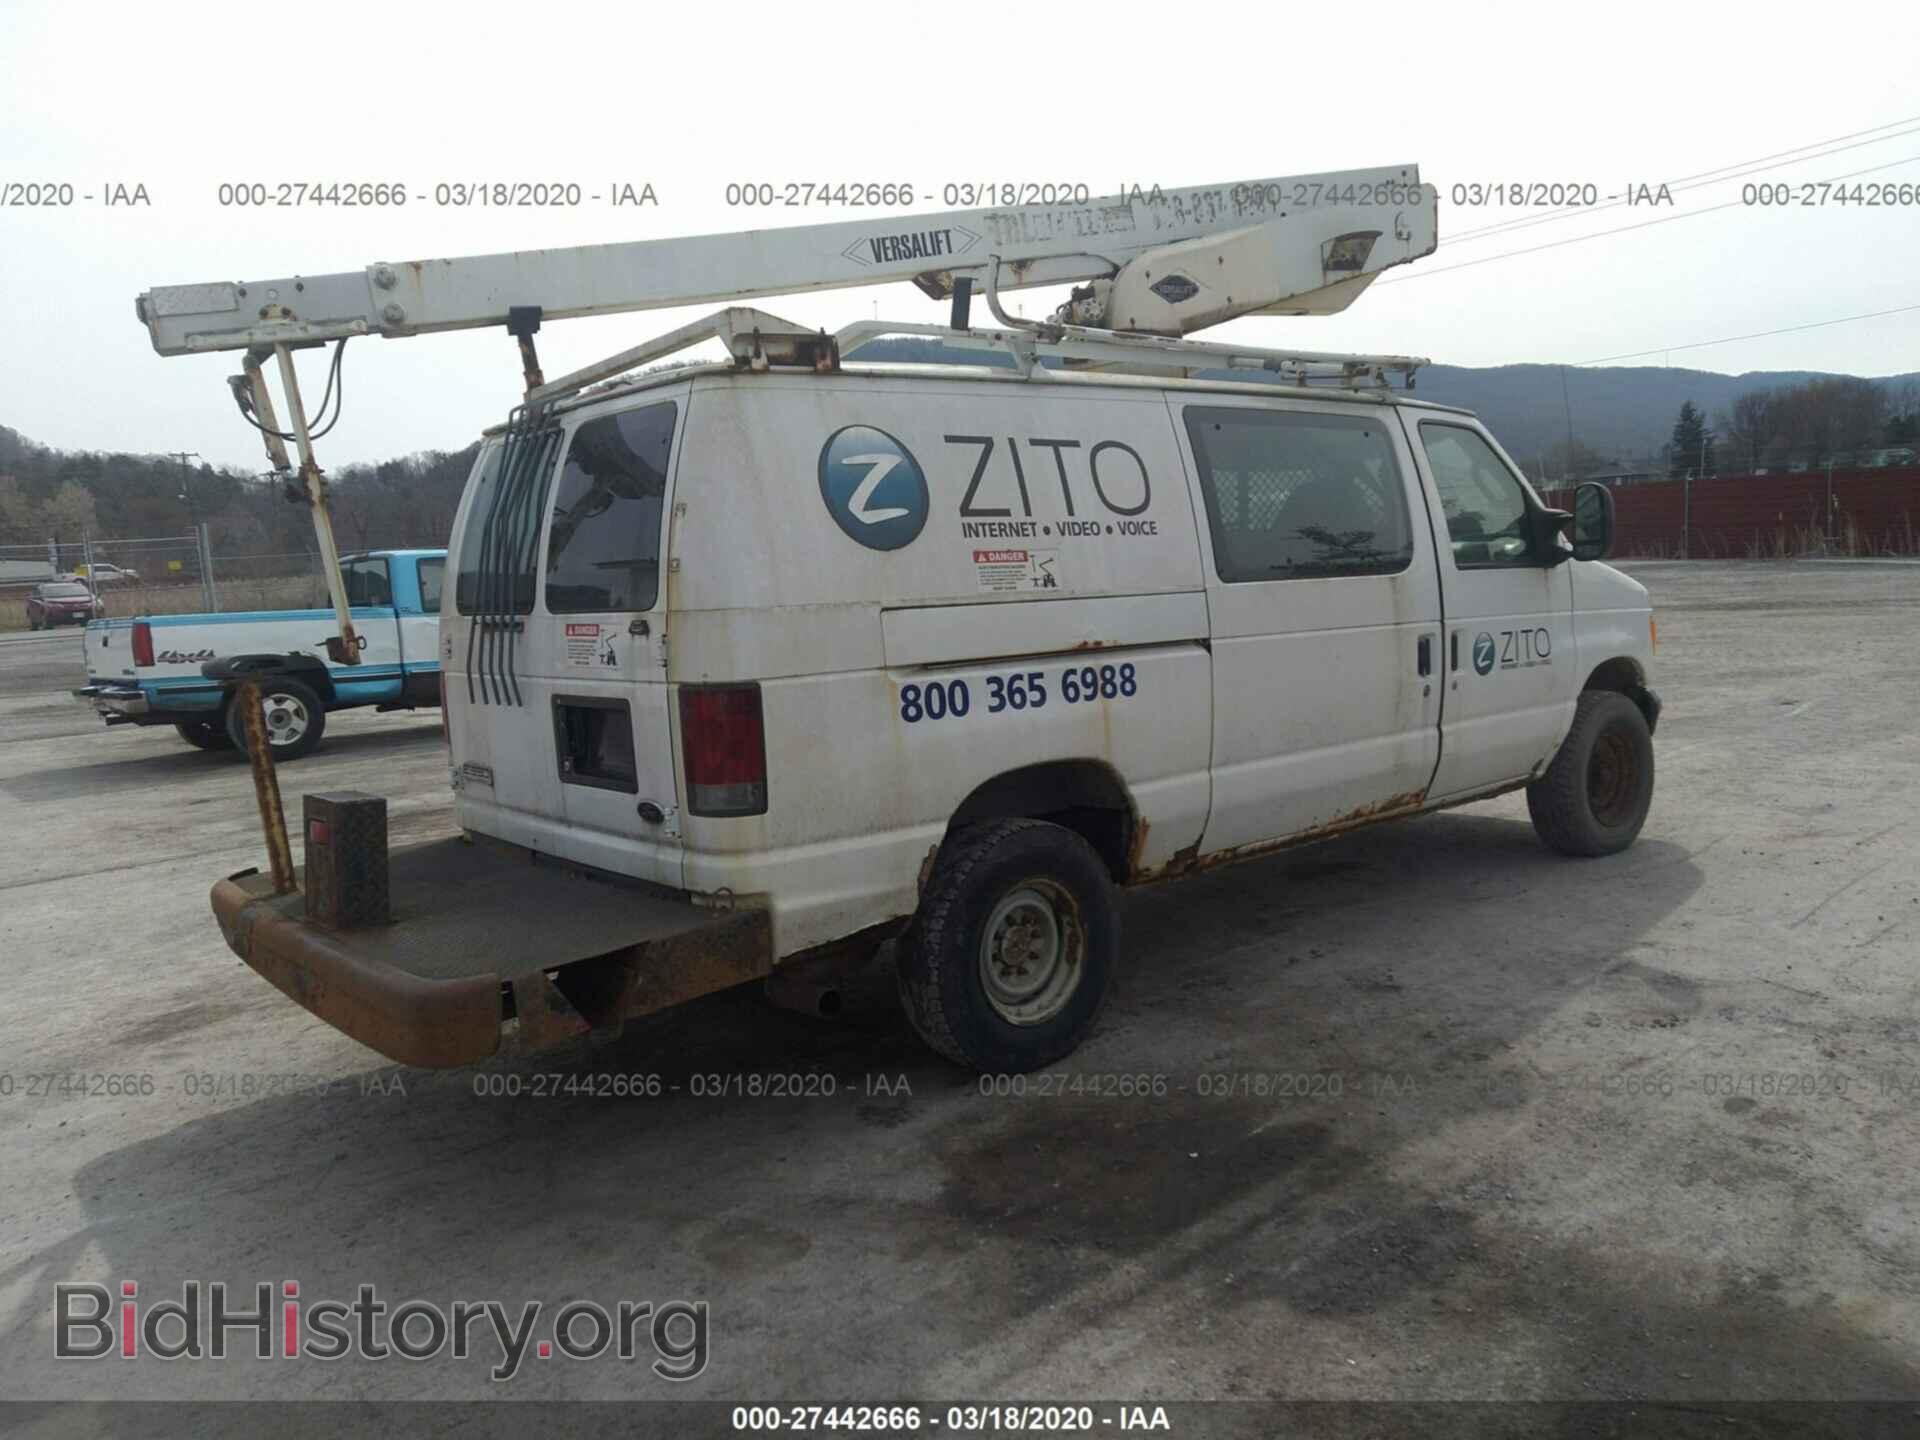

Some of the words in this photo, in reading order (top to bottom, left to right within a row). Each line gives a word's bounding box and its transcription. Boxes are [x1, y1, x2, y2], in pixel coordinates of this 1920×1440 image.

[870, 229, 952, 263] VERSALIFT
[944, 435, 1151, 517] ZITO
[962, 522, 1037, 538] INTERNET
[1056, 521, 1101, 537] VIDEO
[1117, 520, 1158, 536] VOICE
[989, 551, 1025, 561] DANGER
[1502, 627, 1551, 662] ZITO
[900, 681, 970, 722] 800
[986, 673, 1046, 713] 365
[1061, 662, 1137, 704] 6988
